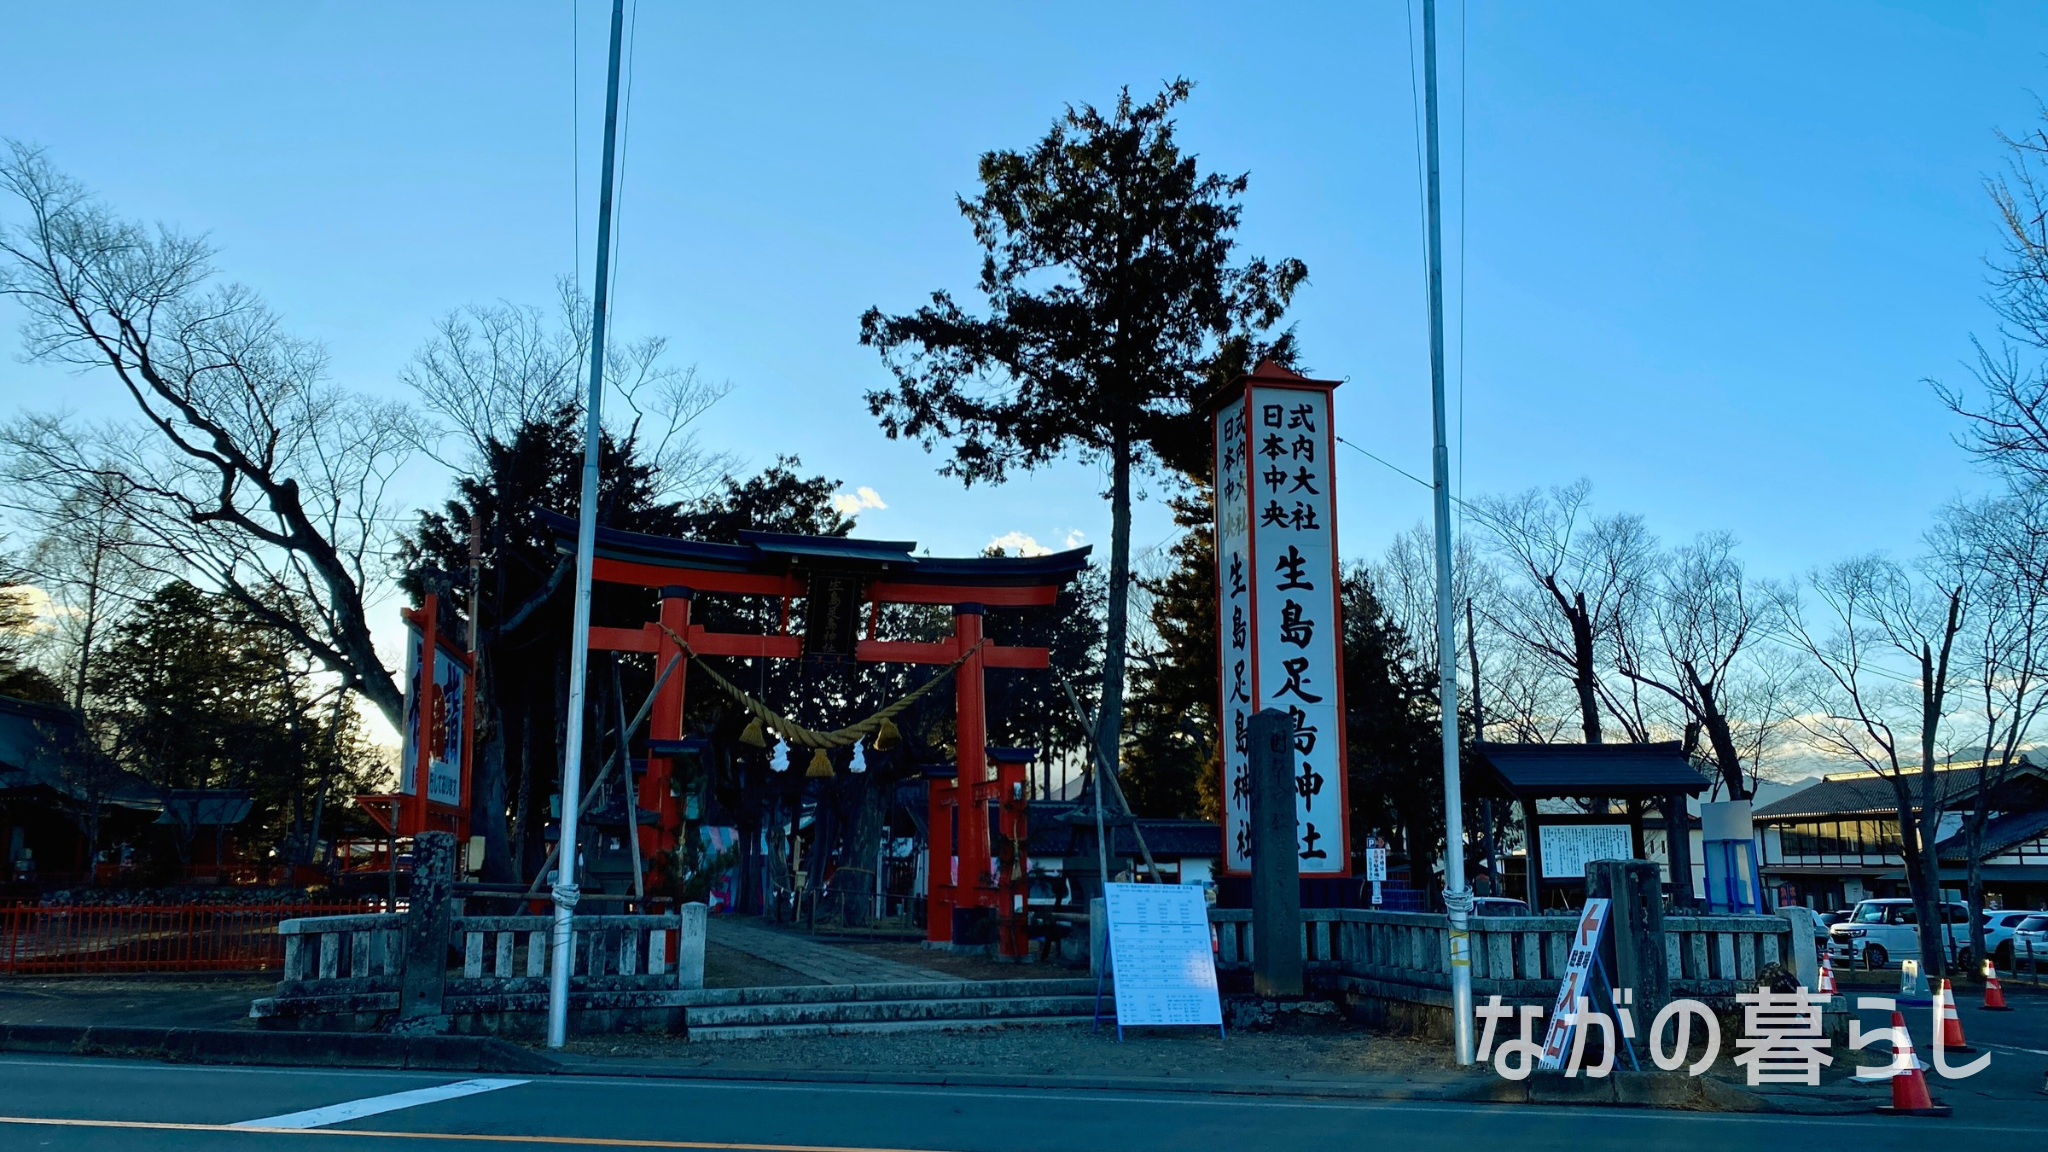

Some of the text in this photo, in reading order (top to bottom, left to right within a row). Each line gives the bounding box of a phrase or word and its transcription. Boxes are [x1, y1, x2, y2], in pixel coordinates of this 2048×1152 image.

[1259, 404, 1289, 529] 日本中央
[1288, 404, 1320, 531] 式内大社
